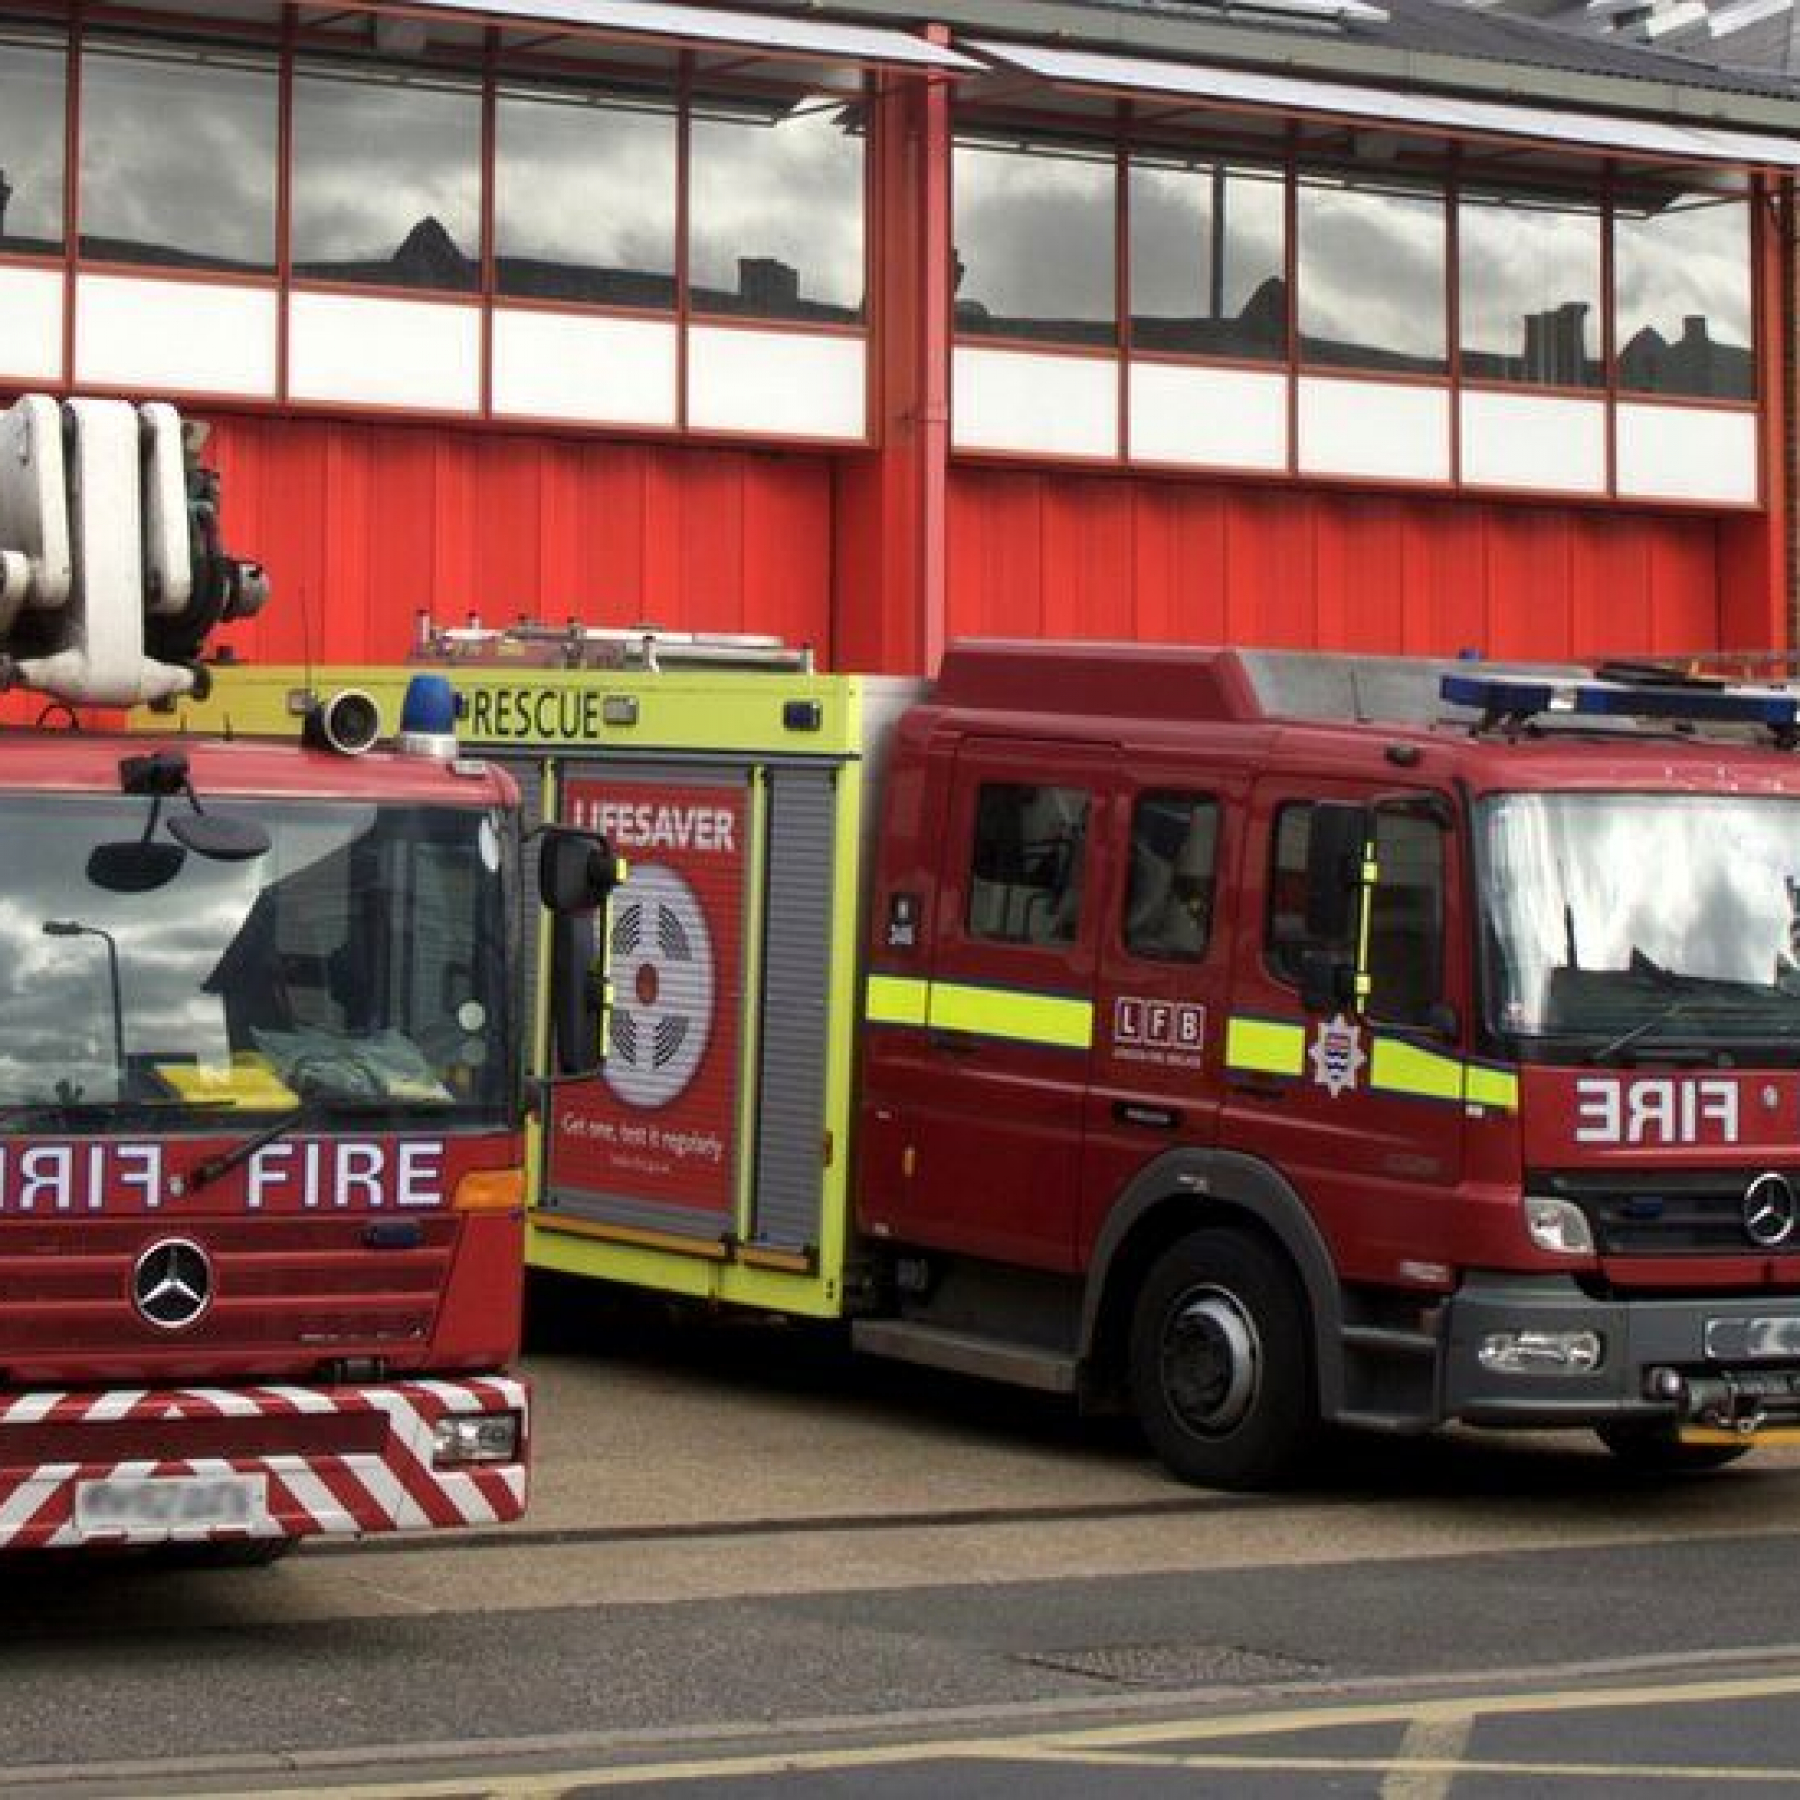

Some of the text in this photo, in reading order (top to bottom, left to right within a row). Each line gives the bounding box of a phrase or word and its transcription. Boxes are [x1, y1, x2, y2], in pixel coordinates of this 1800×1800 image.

[472, 690, 600, 738] RESCUE
[574, 799, 735, 851] LIFESAVER
[246, 1140, 445, 1209] FIRE
